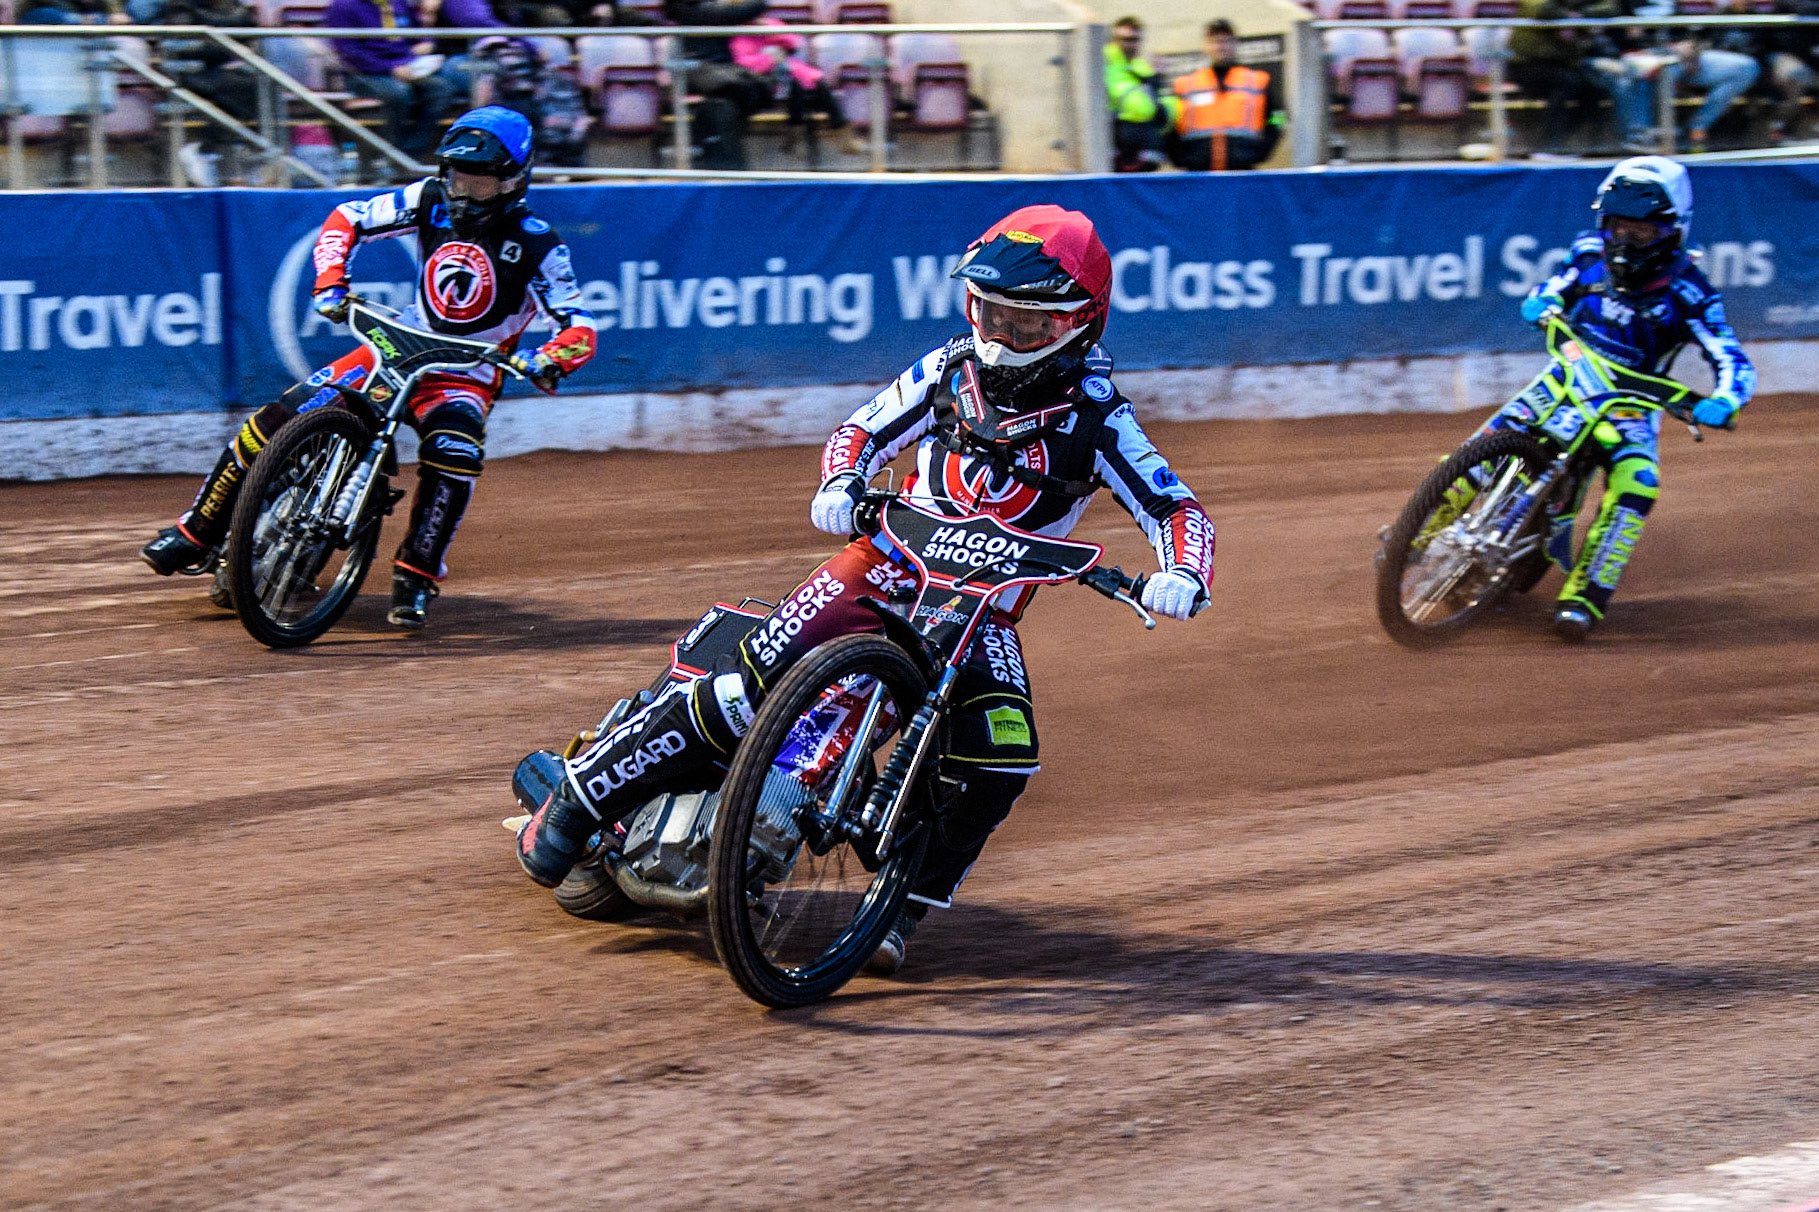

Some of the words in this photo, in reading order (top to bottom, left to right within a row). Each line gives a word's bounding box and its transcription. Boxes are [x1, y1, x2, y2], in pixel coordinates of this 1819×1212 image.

[504, 245, 518, 260] 4
[967, 266, 993, 278] BELL
[526, 256, 875, 343] elivering
[1111, 245, 1275, 313] Class
[1290, 235, 1485, 306] Travel
[0, 271, 223, 351] Travel
[1088, 379, 1108, 396] ATPI
[963, 392, 977, 418] HAGON
[1006, 418, 1037, 432] HAGON
[1006, 424, 1038, 437] SHOCKS
[929, 526, 1030, 560] HAGON
[1182, 507, 1204, 569] HAGON
[922, 543, 1019, 576] SHOCKS
[751, 570, 831, 655] HAGON
[760, 578, 846, 667] SHOCKS
[916, 604, 970, 625] HAGON
[999, 626, 1027, 695] HAGON
[586, 730, 687, 802] DUGARD
